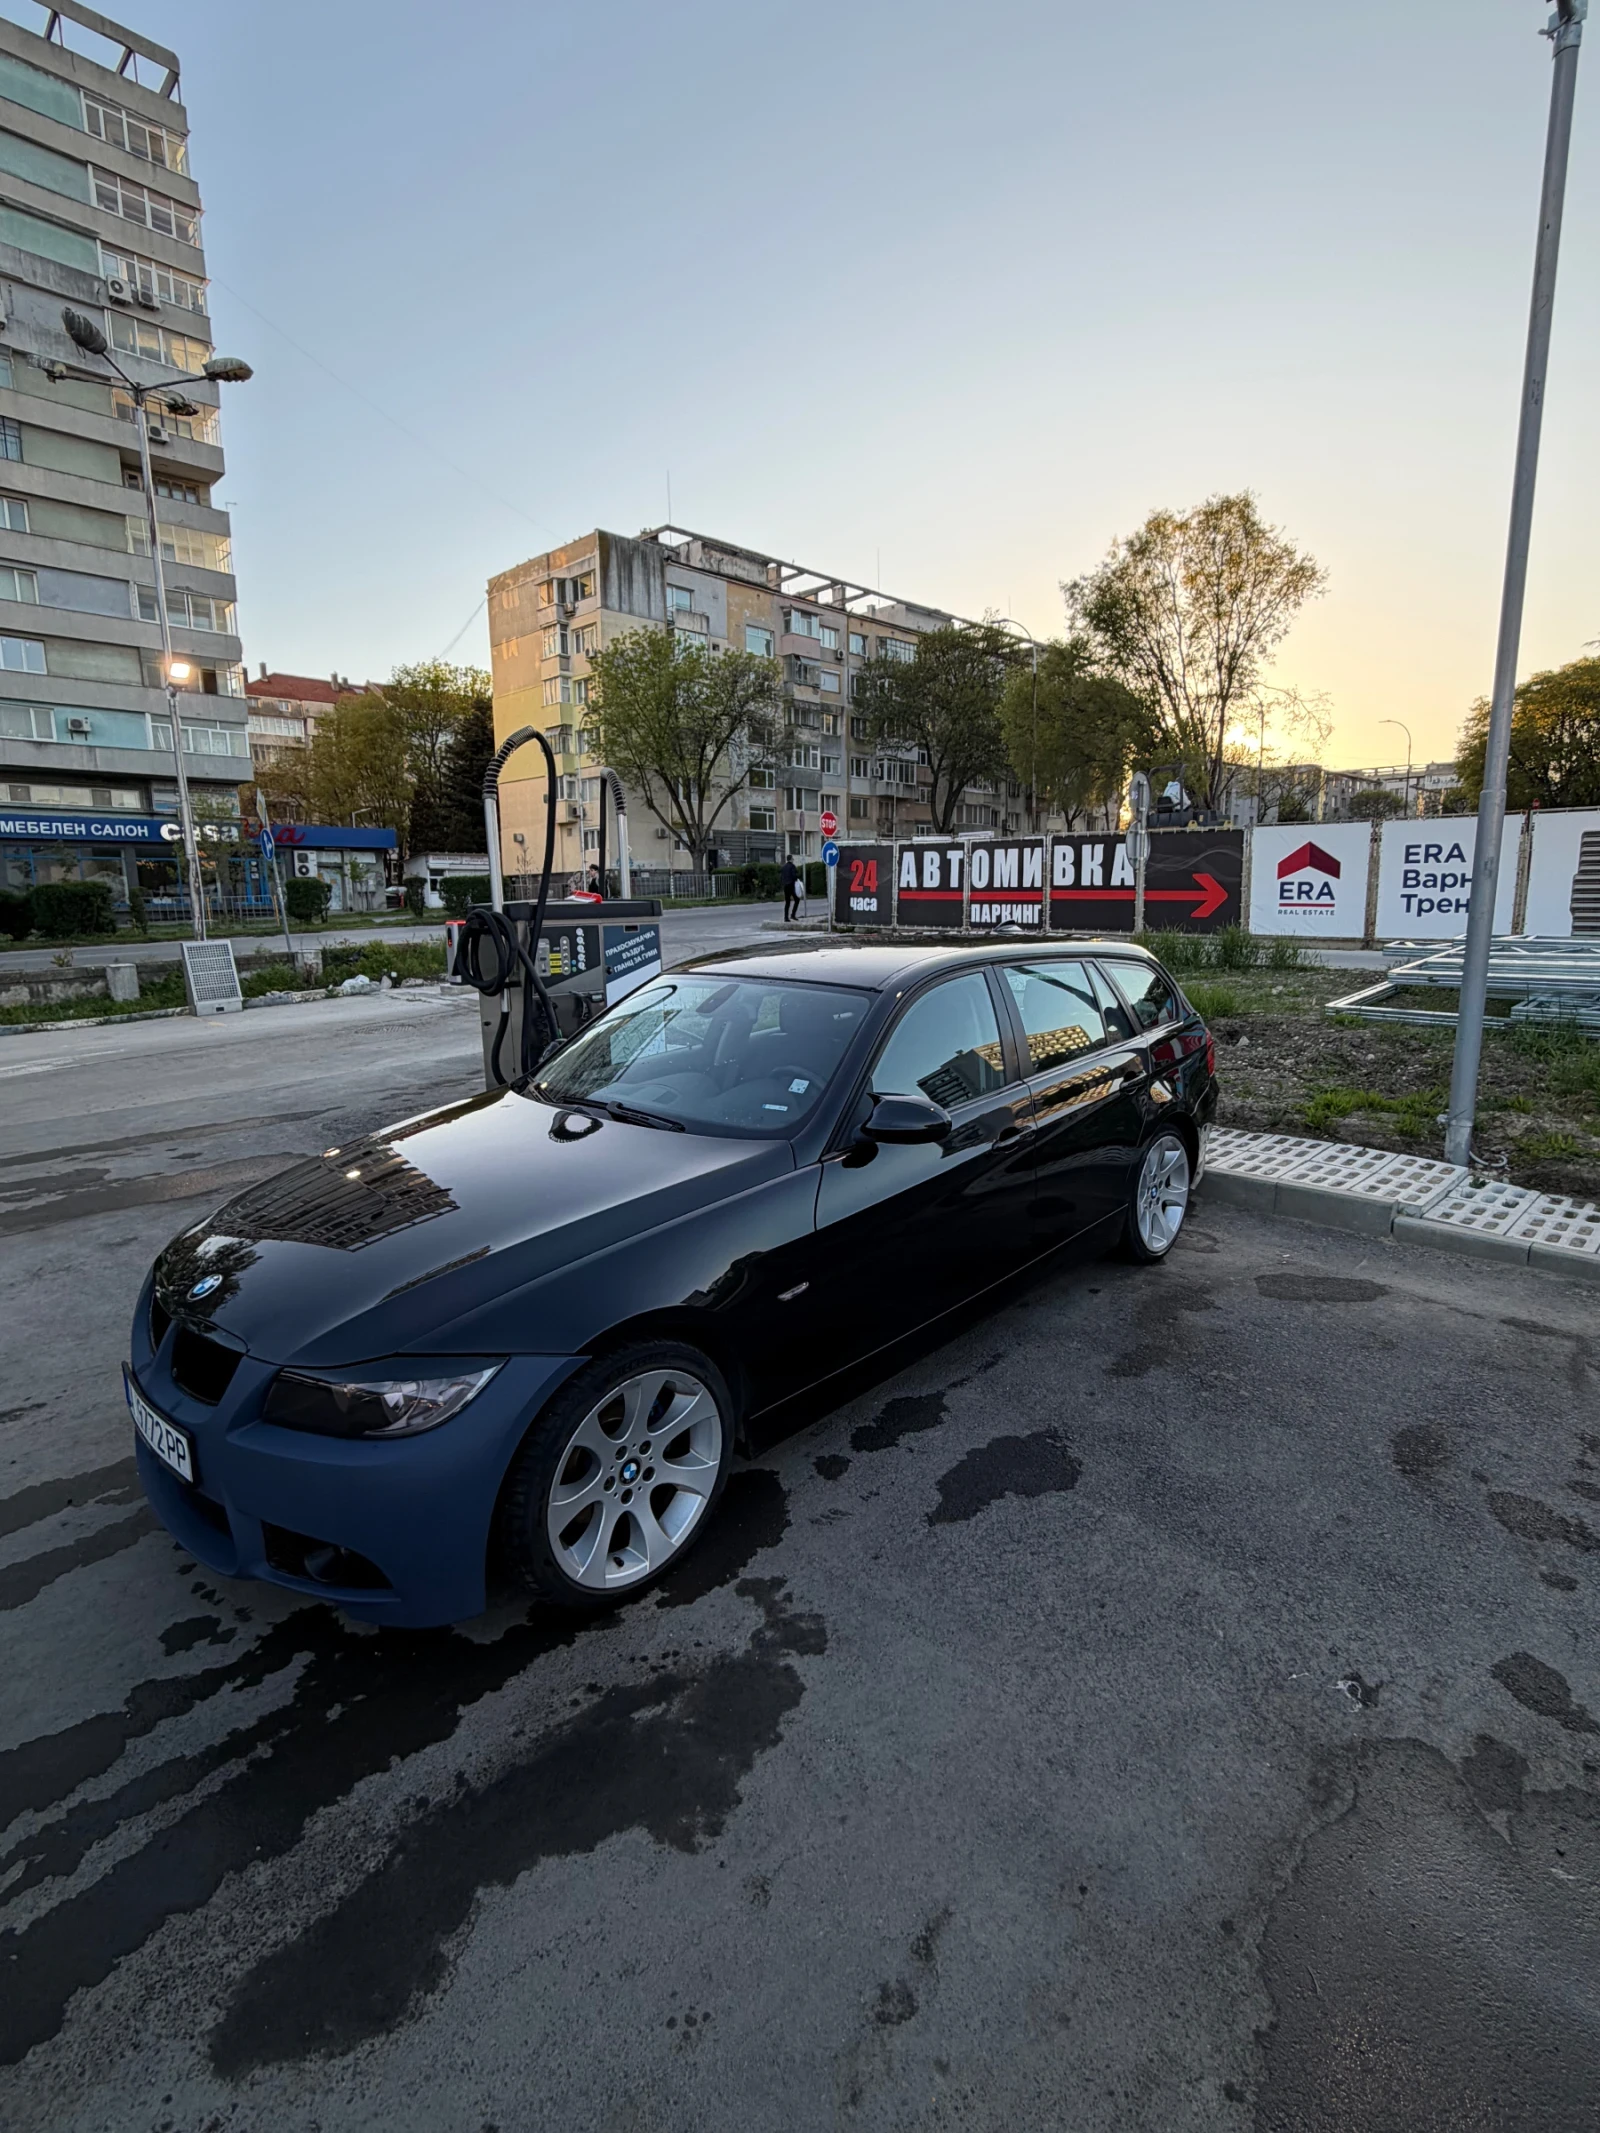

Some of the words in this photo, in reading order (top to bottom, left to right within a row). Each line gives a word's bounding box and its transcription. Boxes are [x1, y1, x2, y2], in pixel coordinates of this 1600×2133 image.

[0, 820, 86, 836] МЕБЕЛЕН
[90, 823, 149, 837] САЛОН
[821, 819, 837, 829] STOP
[1403, 842, 1467, 864] ERA
[850, 860, 878, 892] 24
[1279, 881, 1335, 900] ERA
[850, 897, 878, 911] часа
[970, 903, 1042, 924] ПАРКИНГ
[1400, 893, 1470, 917] Трен
[605, 930, 656, 957] ПРАХОСМУКАЧКА
[621, 944, 645, 960] ВЪЗДУХ
[613, 959, 635, 973] ГЛАНЦ
[633, 955, 643, 964] ЗА
[641, 947, 659, 960] ГУМИ
